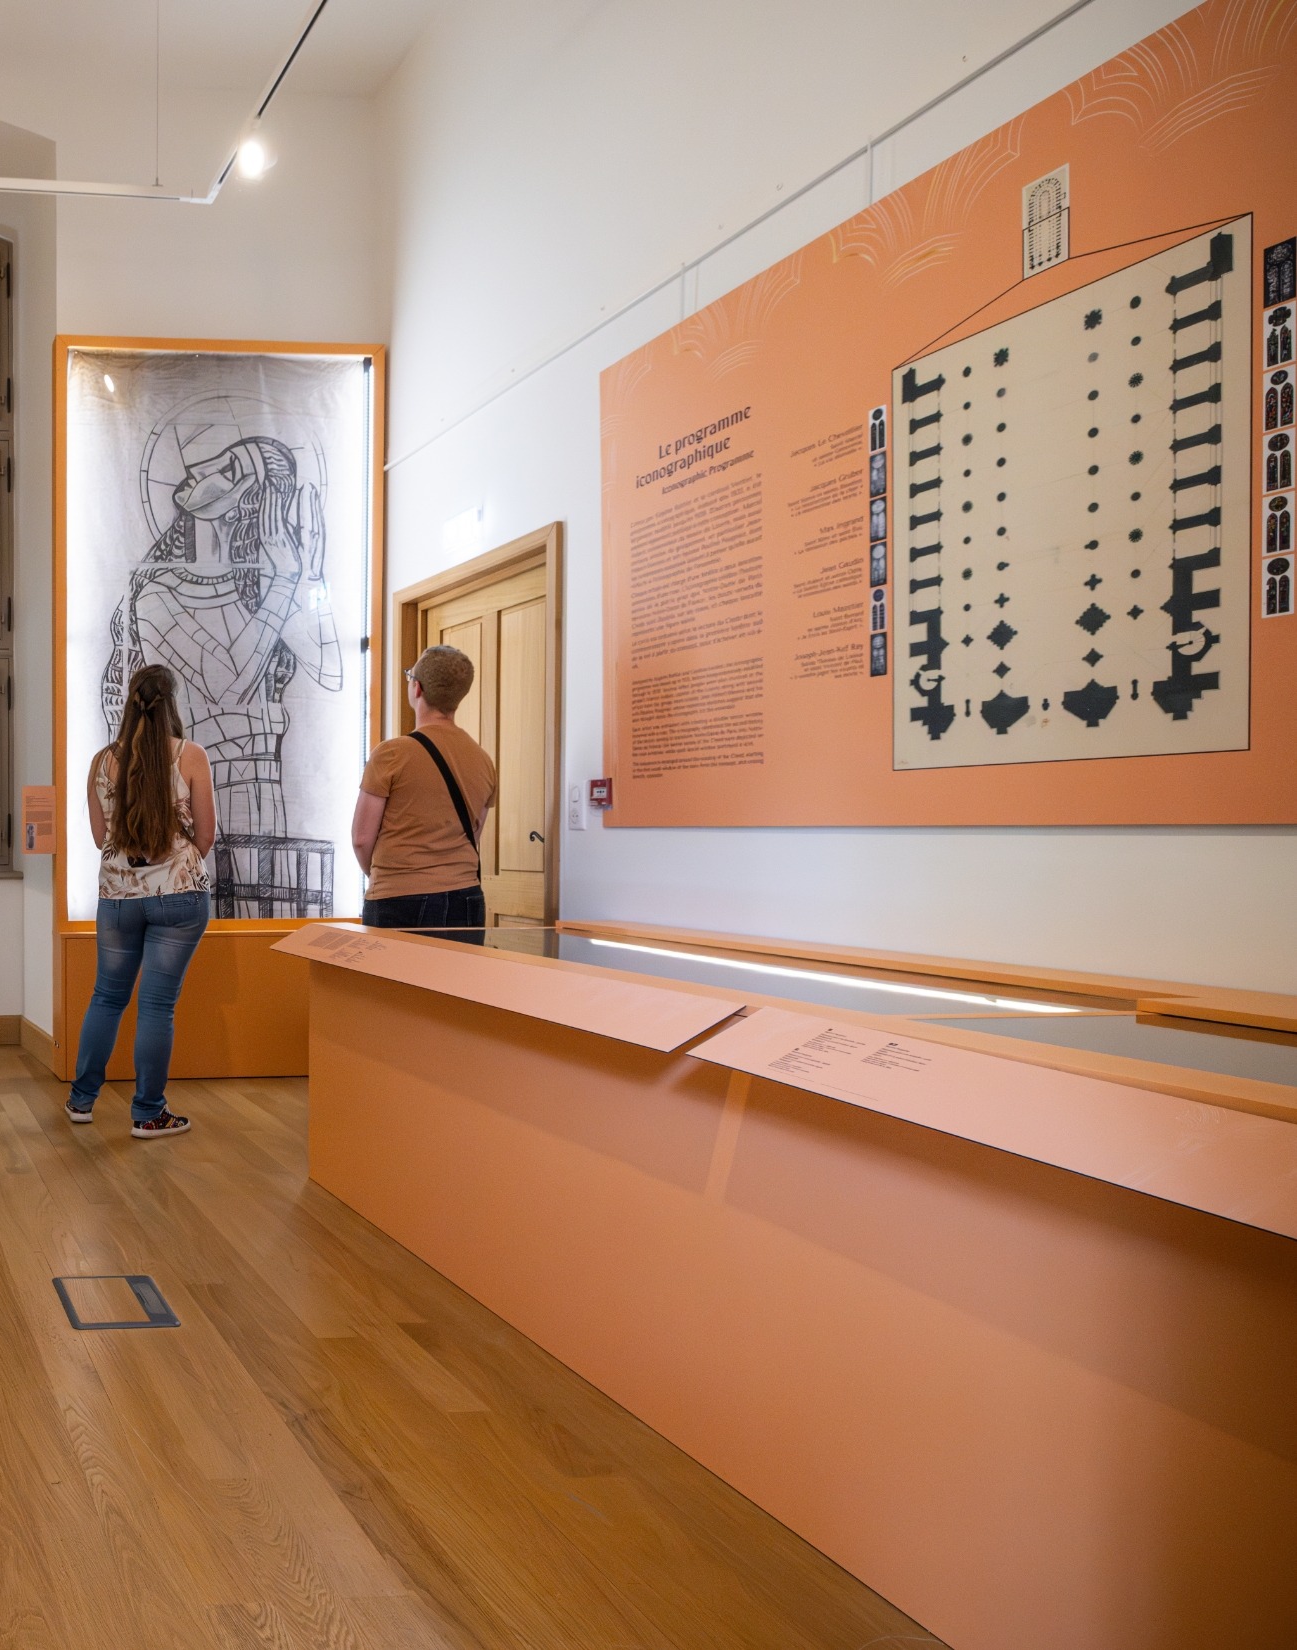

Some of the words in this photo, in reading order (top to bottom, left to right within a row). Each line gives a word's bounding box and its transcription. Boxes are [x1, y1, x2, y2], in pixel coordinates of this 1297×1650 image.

[658, 443, 671, 459] Le
[674, 406, 751, 455] programme
[636, 437, 730, 488] iconographique
